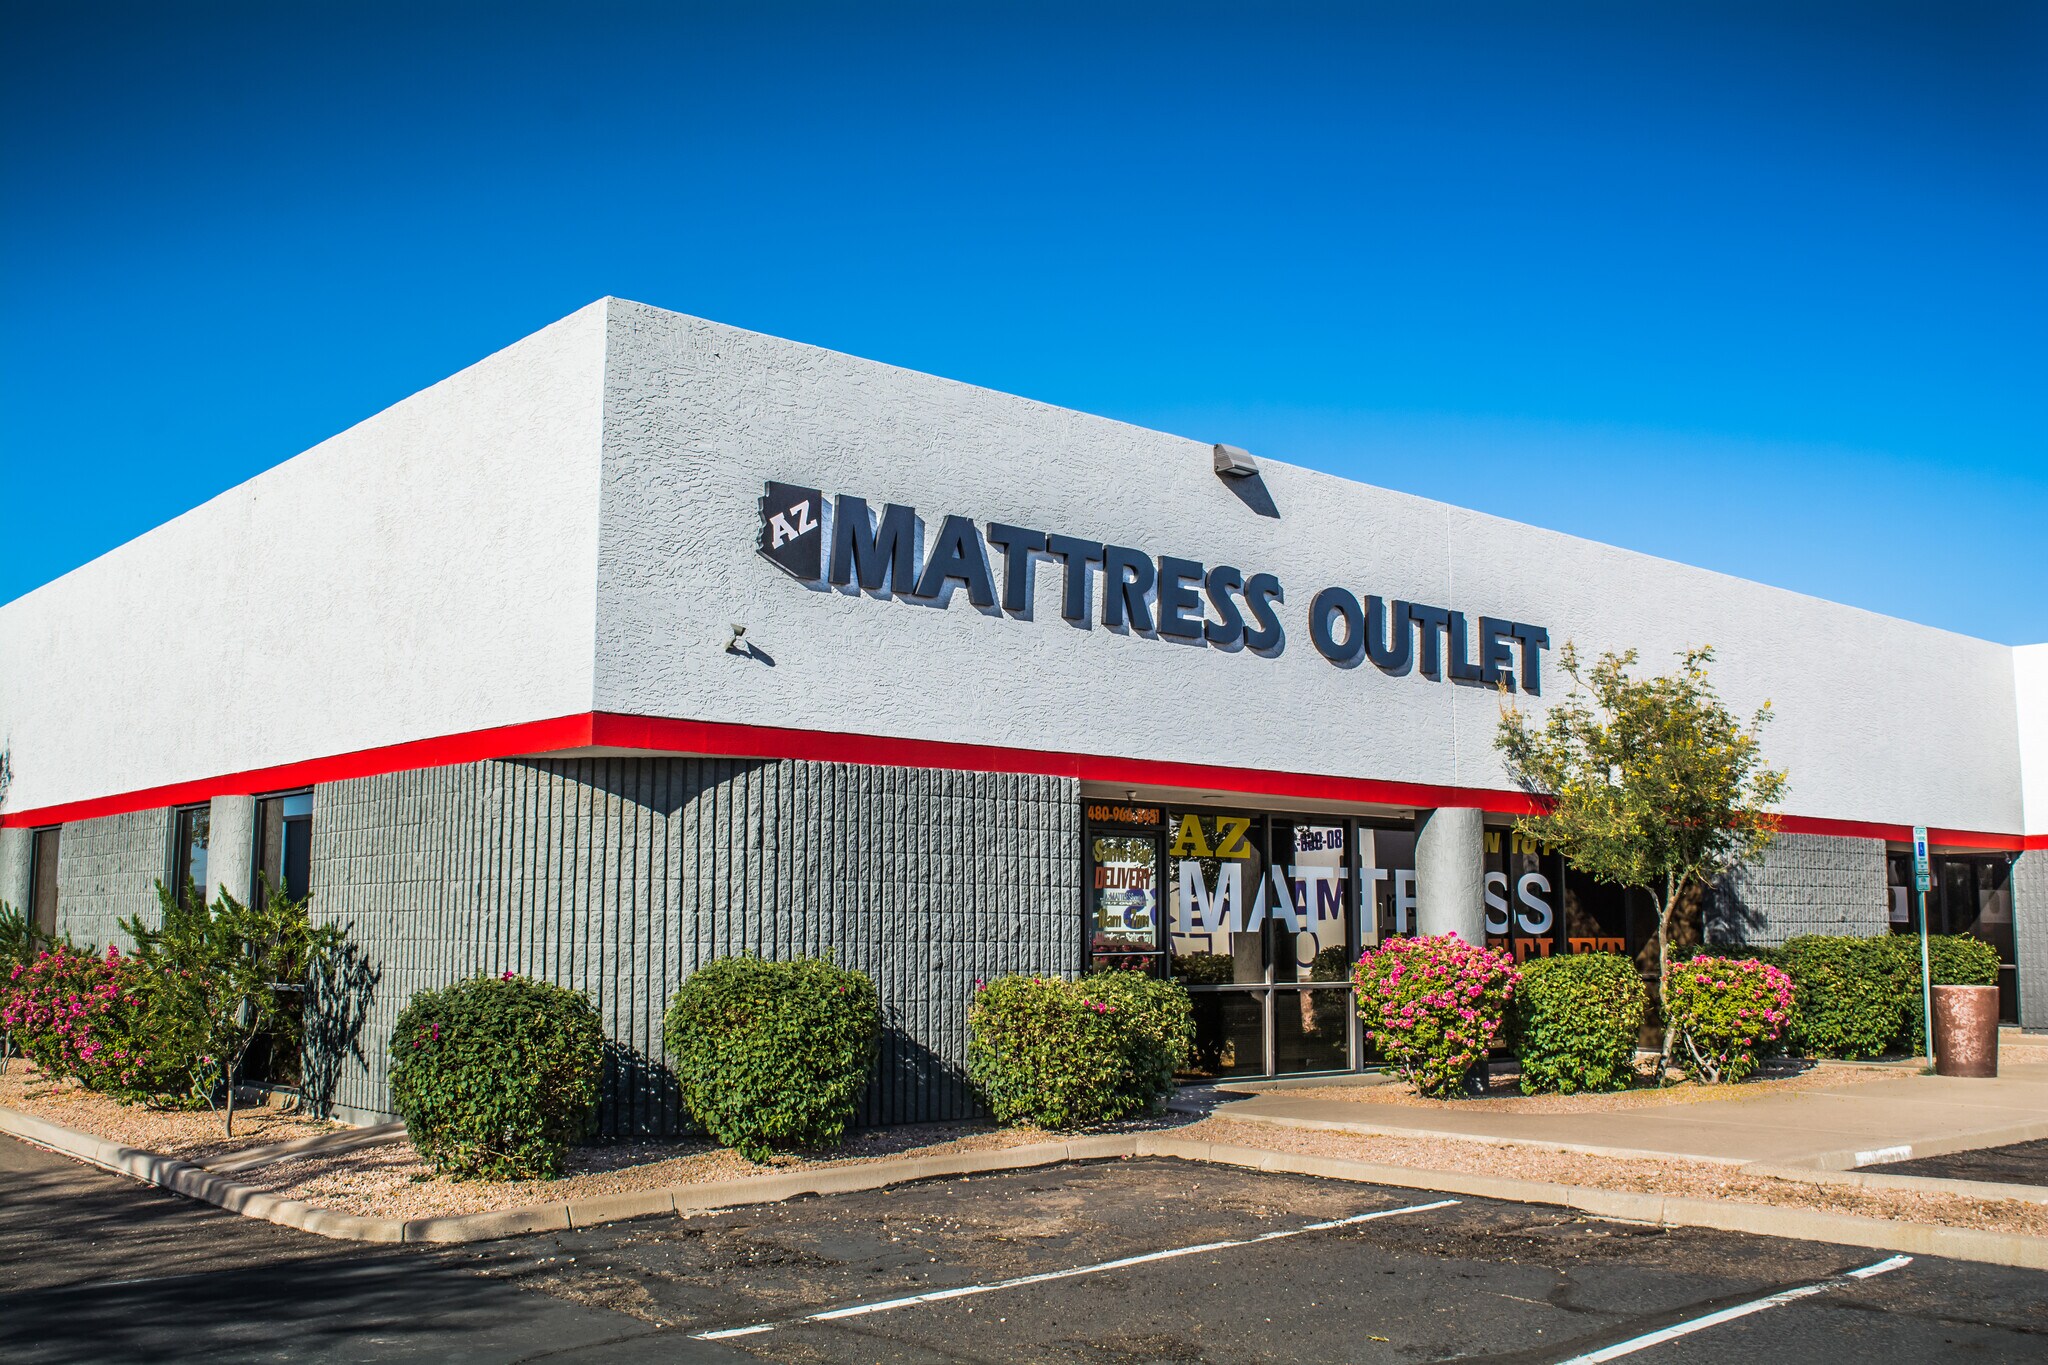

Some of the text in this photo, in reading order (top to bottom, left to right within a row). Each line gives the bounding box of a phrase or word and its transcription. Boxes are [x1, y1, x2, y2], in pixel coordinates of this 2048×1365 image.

[769, 499, 819, 550] AZ
[828, 493, 1548, 690] MATTRESS OUTLET
[1094, 839, 1127, 863] Same
[1169, 814, 1251, 859] AZ
[1095, 867, 1152, 889] DELIVERY
[1098, 908, 1122, 928] 10am
[1130, 908, 1150, 929] 7pm
